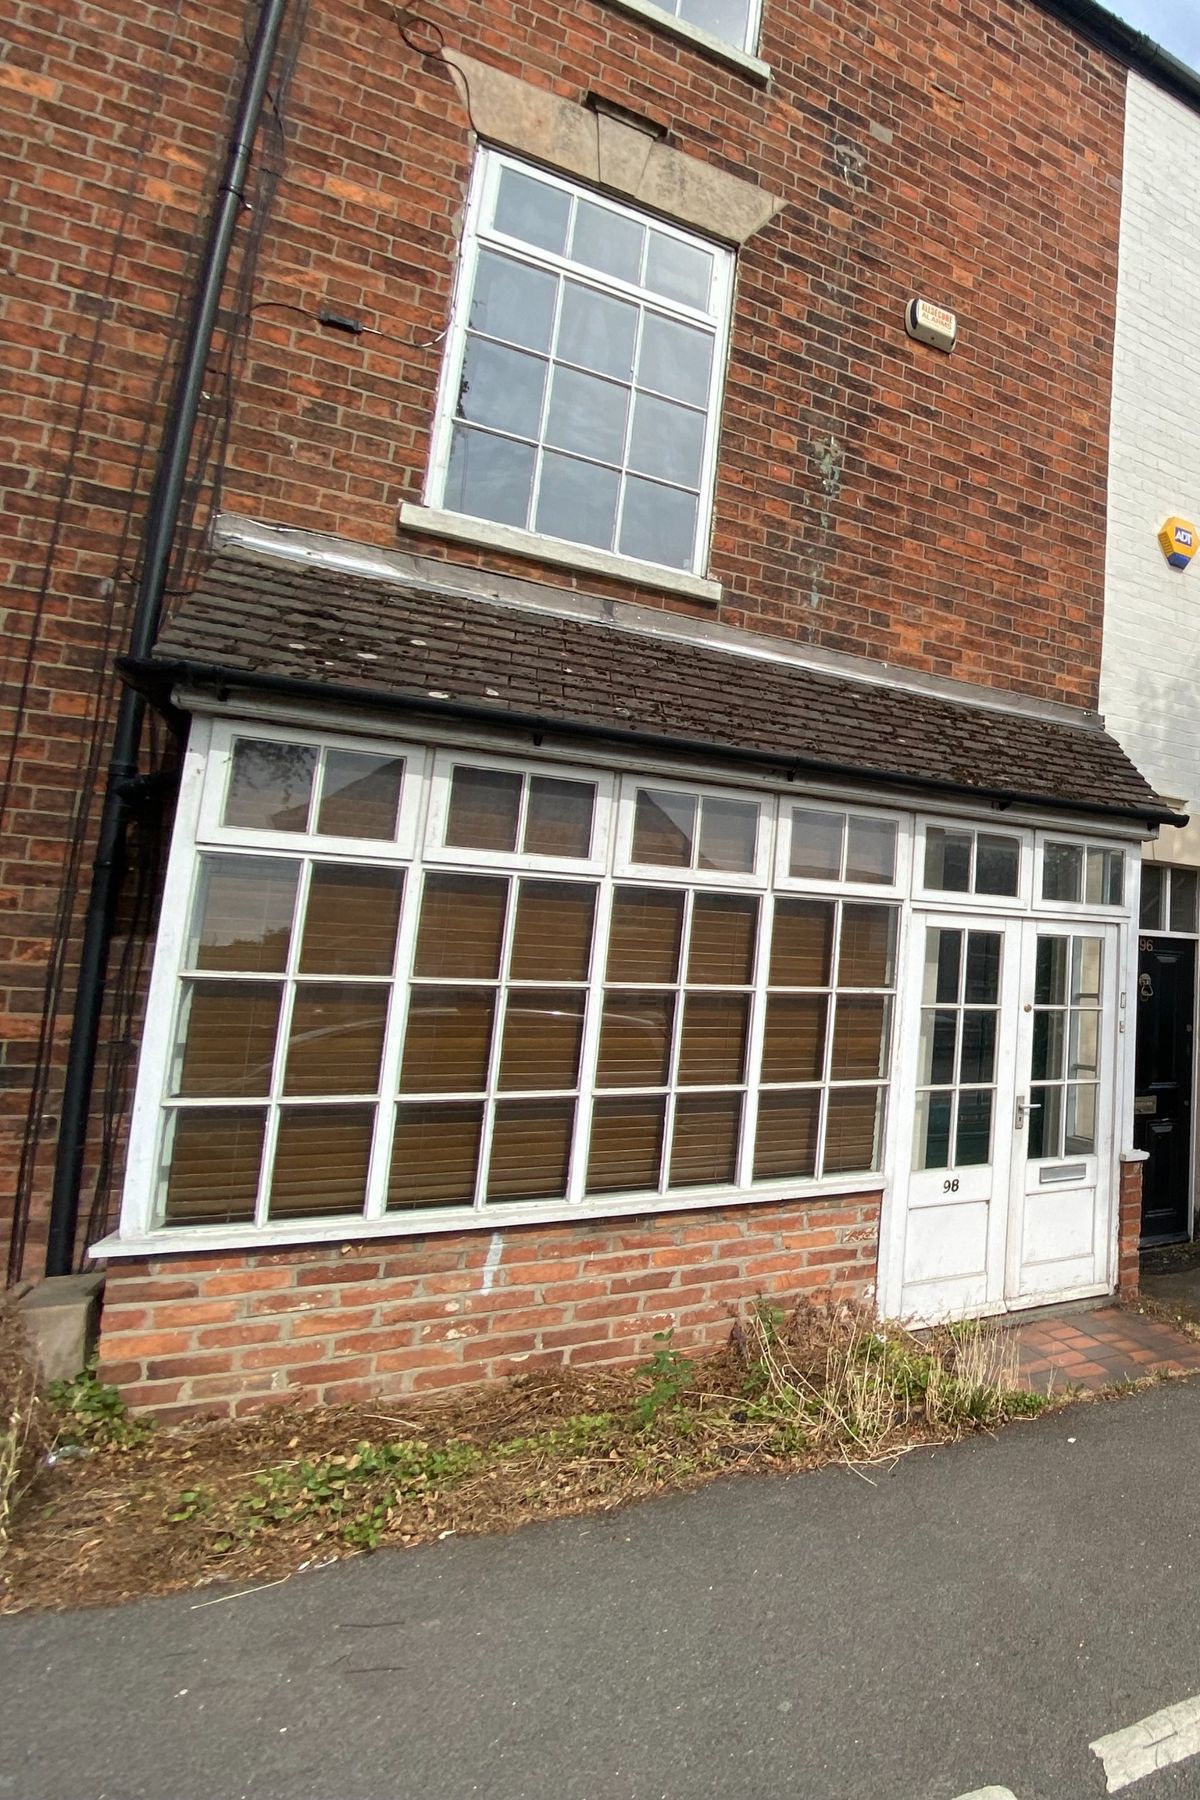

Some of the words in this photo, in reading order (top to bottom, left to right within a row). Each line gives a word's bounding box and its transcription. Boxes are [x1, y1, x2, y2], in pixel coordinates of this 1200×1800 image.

[1175, 529, 1192, 545] ADT
[1140, 939, 1153, 951] 96
[943, 1179, 960, 1194] 98
